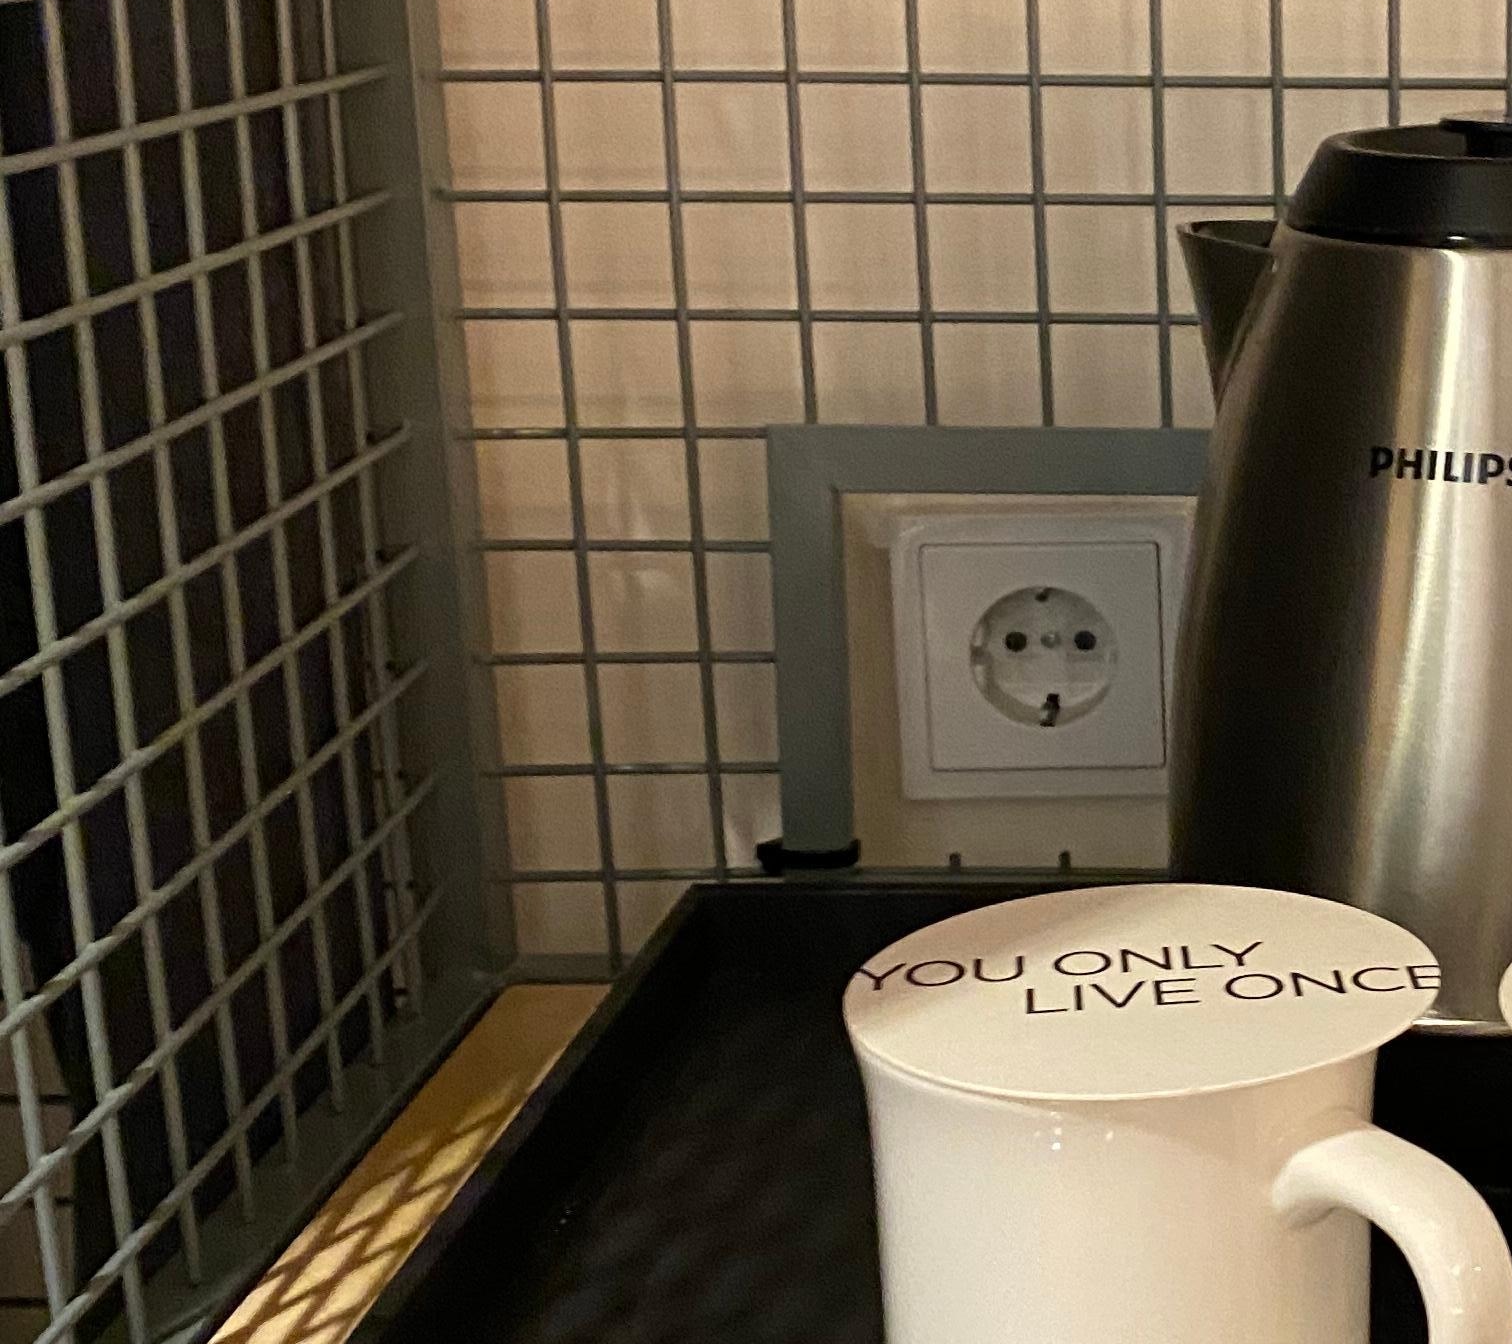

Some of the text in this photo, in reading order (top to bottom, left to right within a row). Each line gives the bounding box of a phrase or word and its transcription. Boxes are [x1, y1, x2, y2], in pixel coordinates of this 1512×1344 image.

[859, 940, 1264, 992] YOU ONLY
[1025, 963, 1442, 1016] LIVE ONCE
